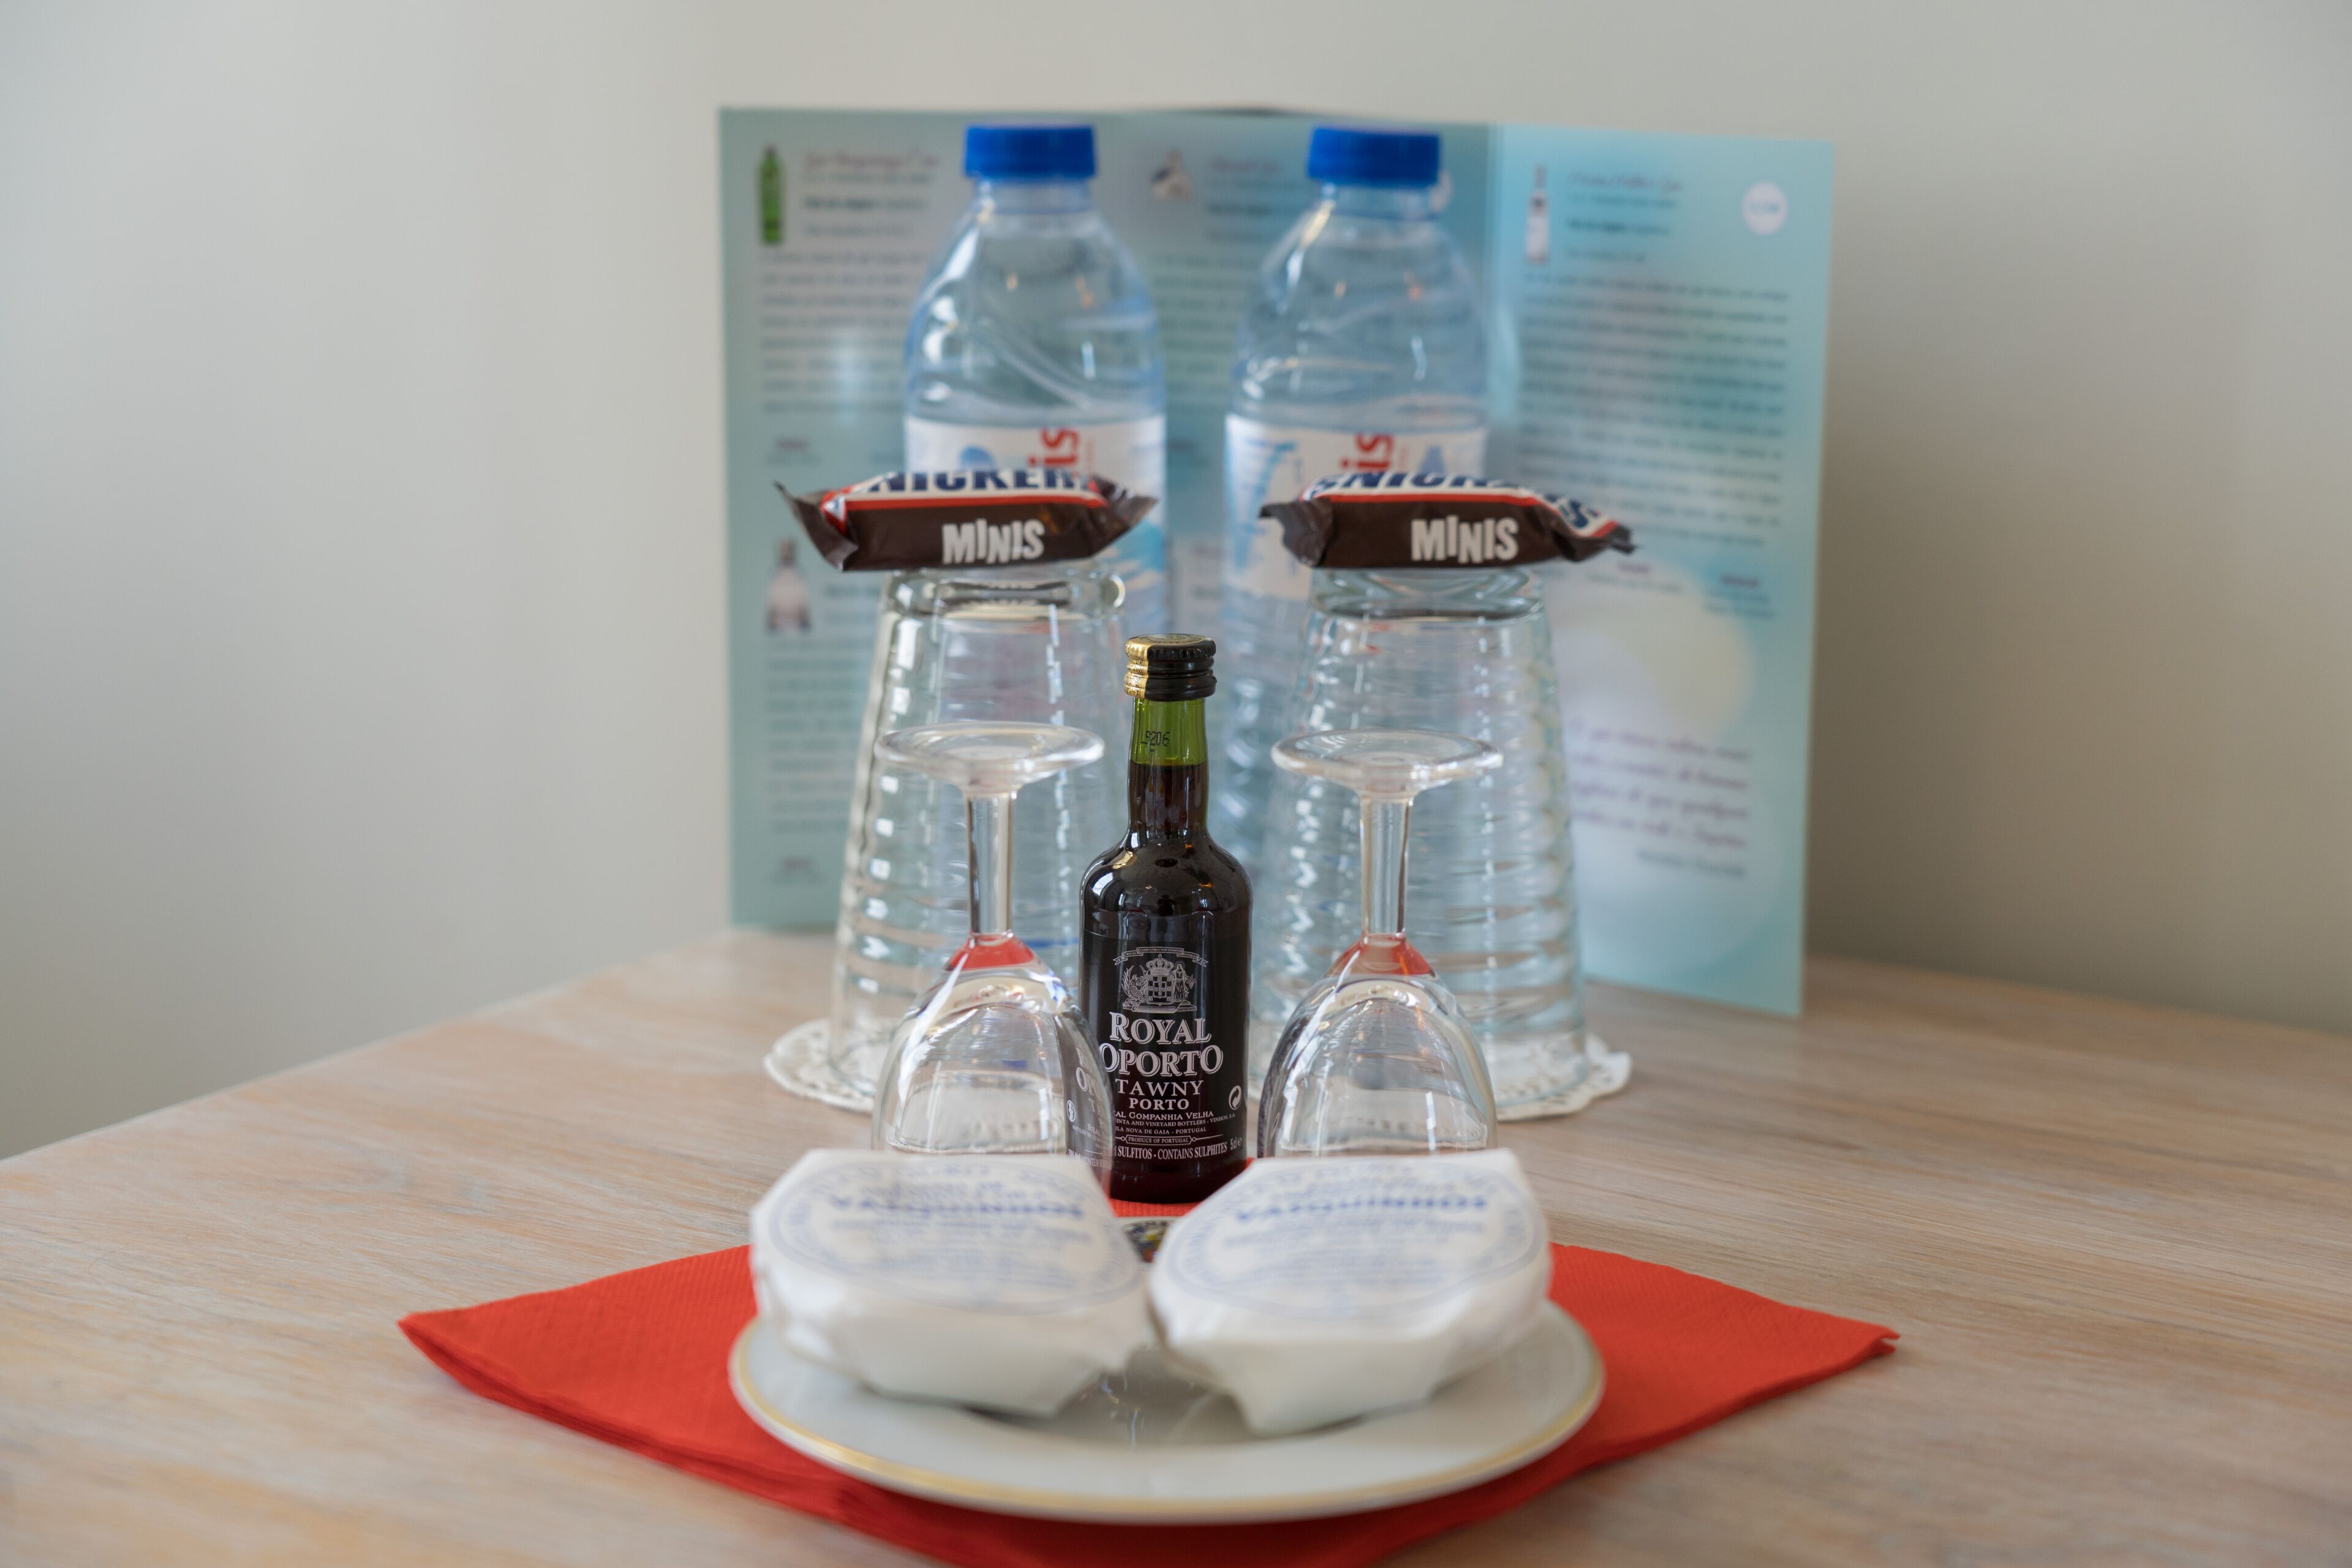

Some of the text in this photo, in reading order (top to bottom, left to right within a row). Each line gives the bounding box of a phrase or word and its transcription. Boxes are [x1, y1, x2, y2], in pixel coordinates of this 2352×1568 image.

[942, 518, 1045, 565] MINIS
[1411, 515, 1519, 564] MINIS
[1109, 1012, 1212, 1044] ROYAL
[1099, 1042, 1223, 1077] OPORTO
[1115, 1079, 1204, 1096] TAWNY
[1129, 1098, 1189, 1110] PORTO
[1129, 1112, 1183, 1120] COMPANHIA
[1186, 1110, 1213, 1120] VELHA
[1118, 1145, 1152, 1159] SULFITOS
[1158, 1147, 1193, 1159] CONTAINS
[1194, 1142, 1227, 1158] SULPHITES
